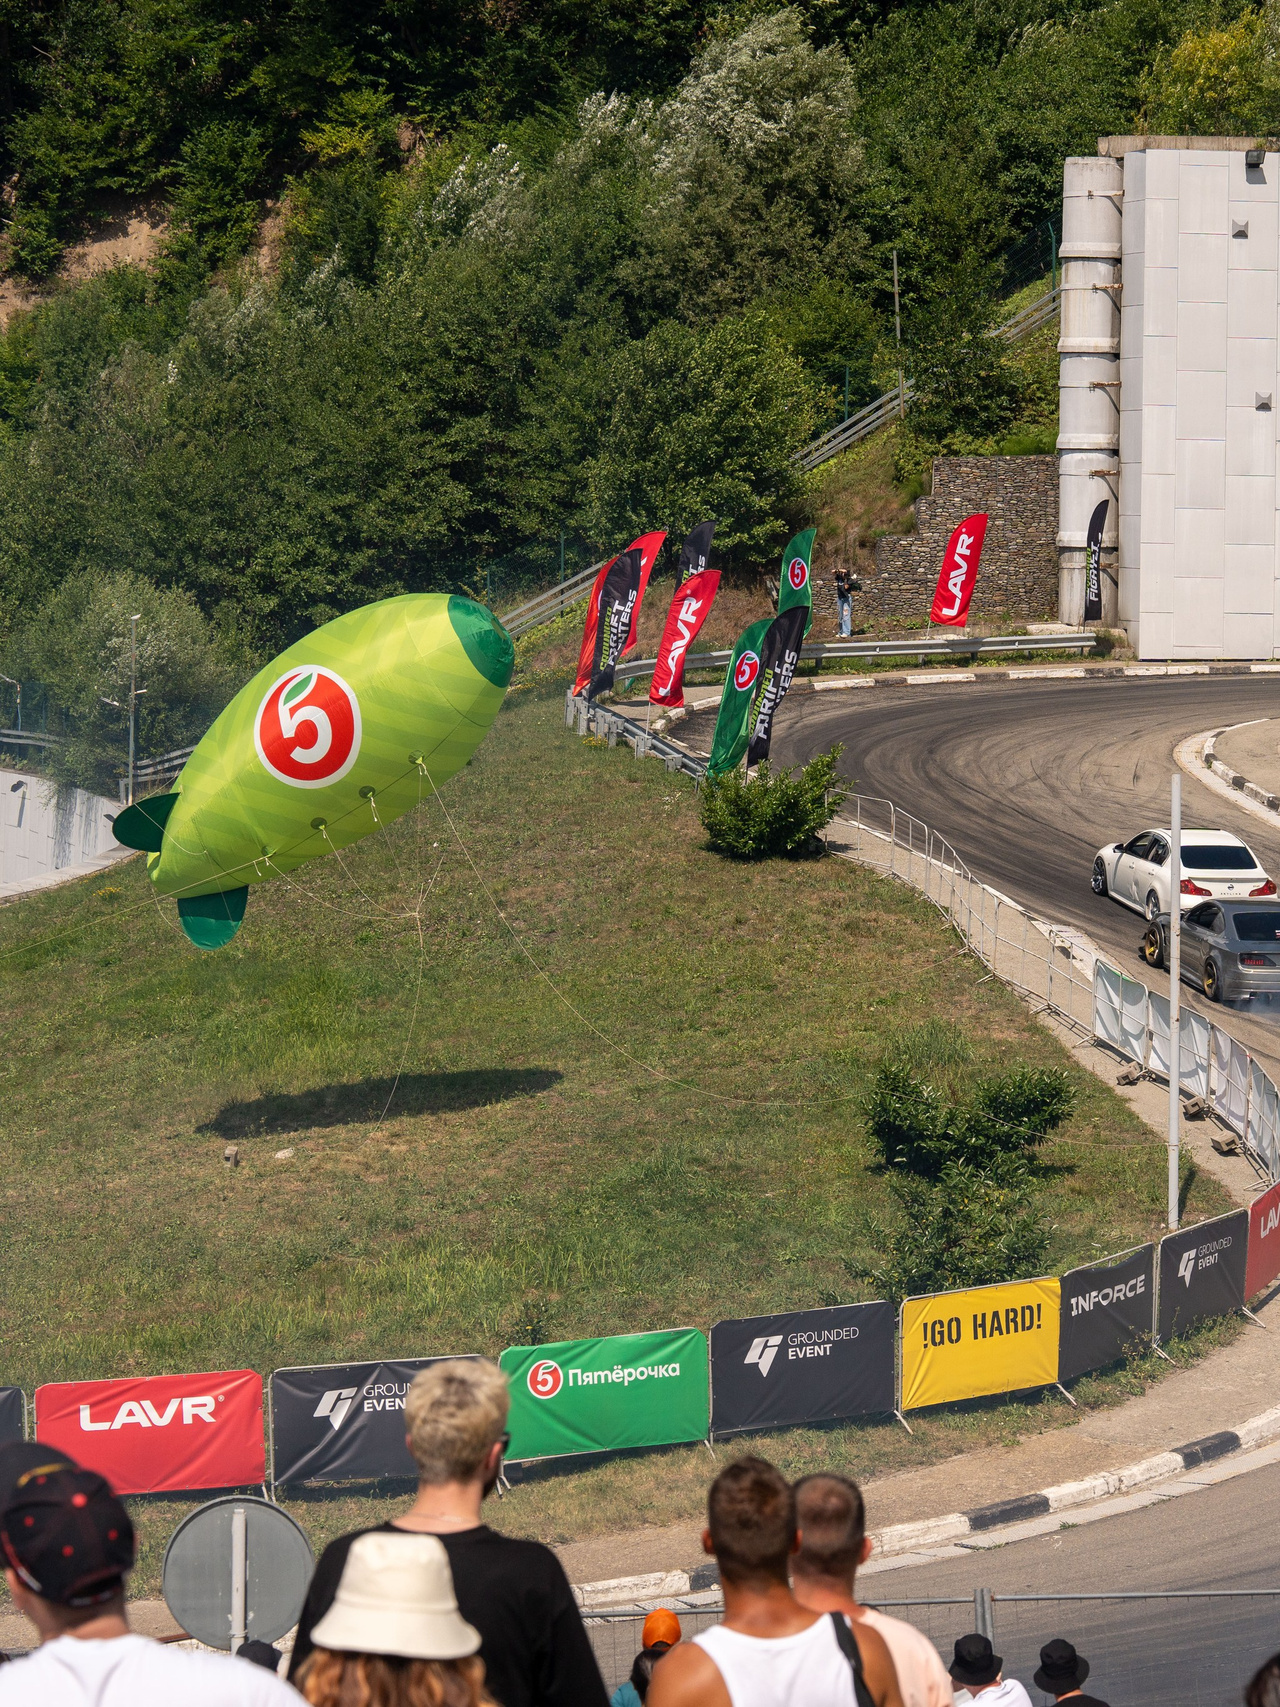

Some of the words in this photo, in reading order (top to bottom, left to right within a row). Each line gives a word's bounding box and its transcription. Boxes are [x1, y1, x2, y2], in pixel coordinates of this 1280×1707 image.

[1198, 1236, 1232, 1257] GROUNDED
[1198, 1253, 1218, 1270] EVENT
[1070, 1273, 1146, 1317] INFORCE
[787, 1326, 860, 1346] GROUNDED
[922, 1316, 962, 1349] !GO
[972, 1303, 1042, 1341] HARD!
[788, 1343, 833, 1360] EVENT
[568, 1363, 681, 1387] Пятёрочка
[363, 1397, 407, 1412] EVEN
